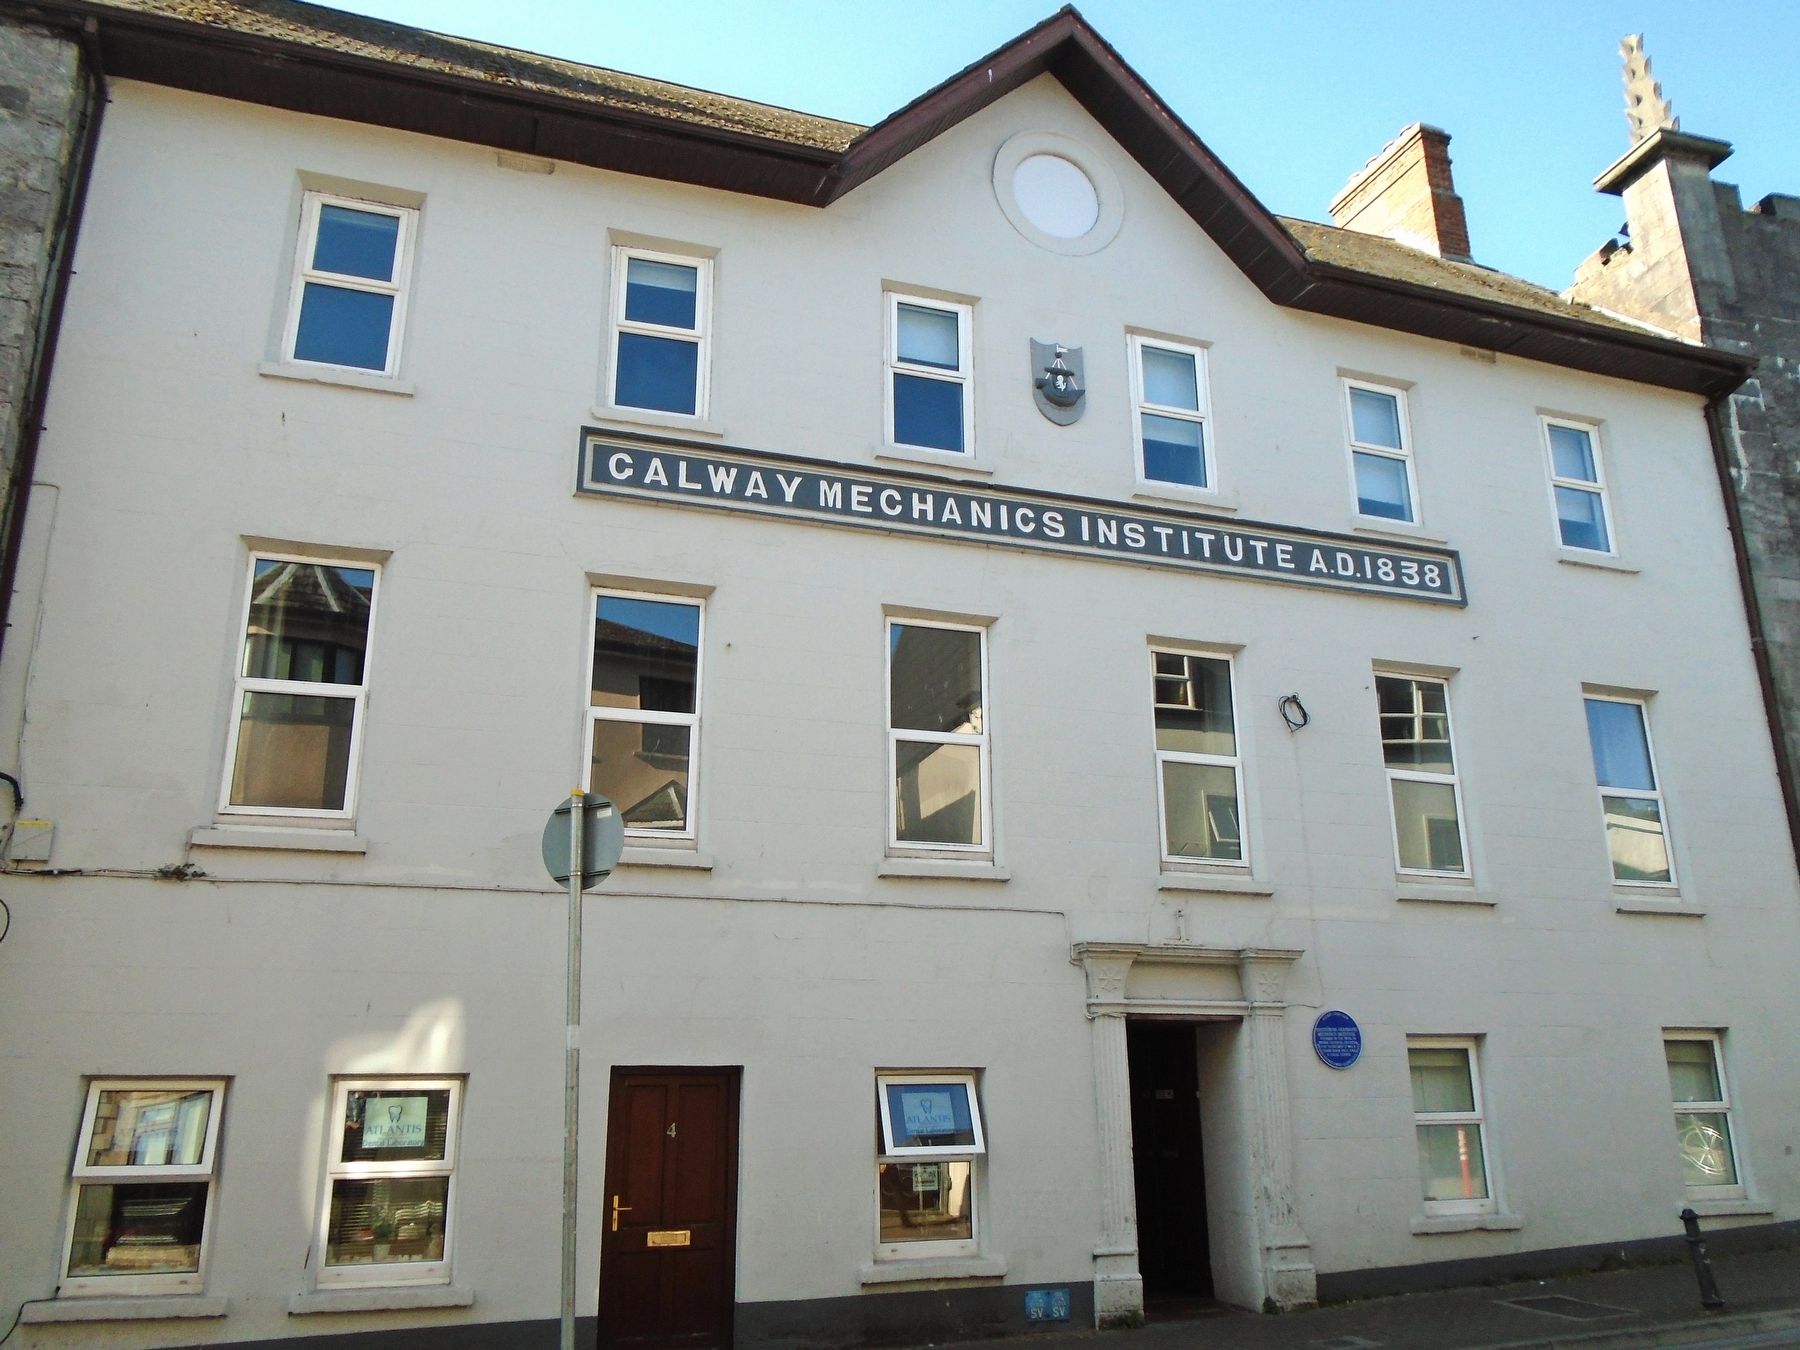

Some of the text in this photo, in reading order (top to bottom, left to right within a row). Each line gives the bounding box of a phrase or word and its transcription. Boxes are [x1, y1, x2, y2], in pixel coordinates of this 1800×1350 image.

[608, 452, 802, 502] GALWAY
[819, 480, 1066, 538] MECHANICS
[1081, 515, 1295, 570] INSTITUTE
[366, 1124, 422, 1135] ATLANTIS
[667, 1122, 677, 1138] 4
